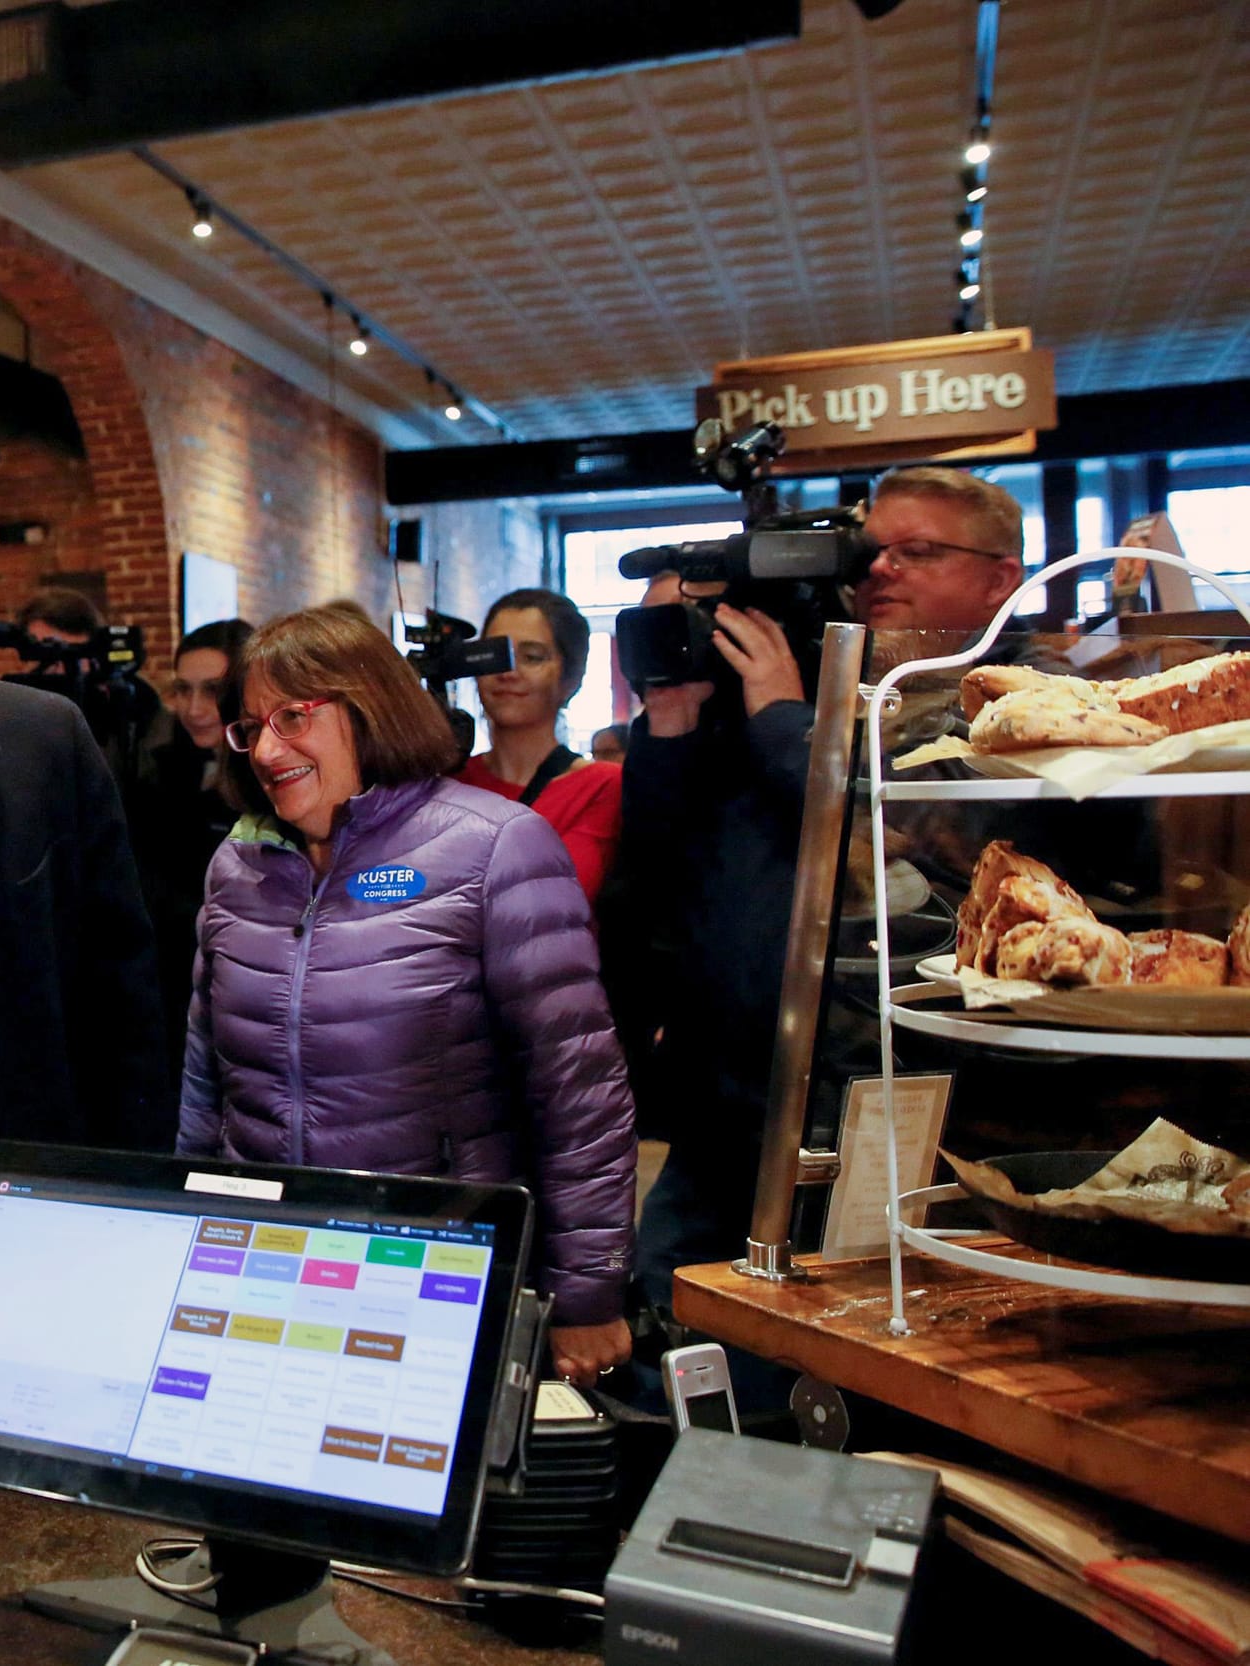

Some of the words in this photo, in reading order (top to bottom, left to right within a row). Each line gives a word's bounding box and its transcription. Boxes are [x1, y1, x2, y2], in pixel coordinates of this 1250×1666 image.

[717, 384, 816, 433] Pick
[824, 382, 888, 431] up
[899, 368, 1027, 417] Here
[357, 869, 415, 884] KUSTER
[363, 889, 407, 898] CONGRESS
[621, 1623, 679, 1651] EPSON
